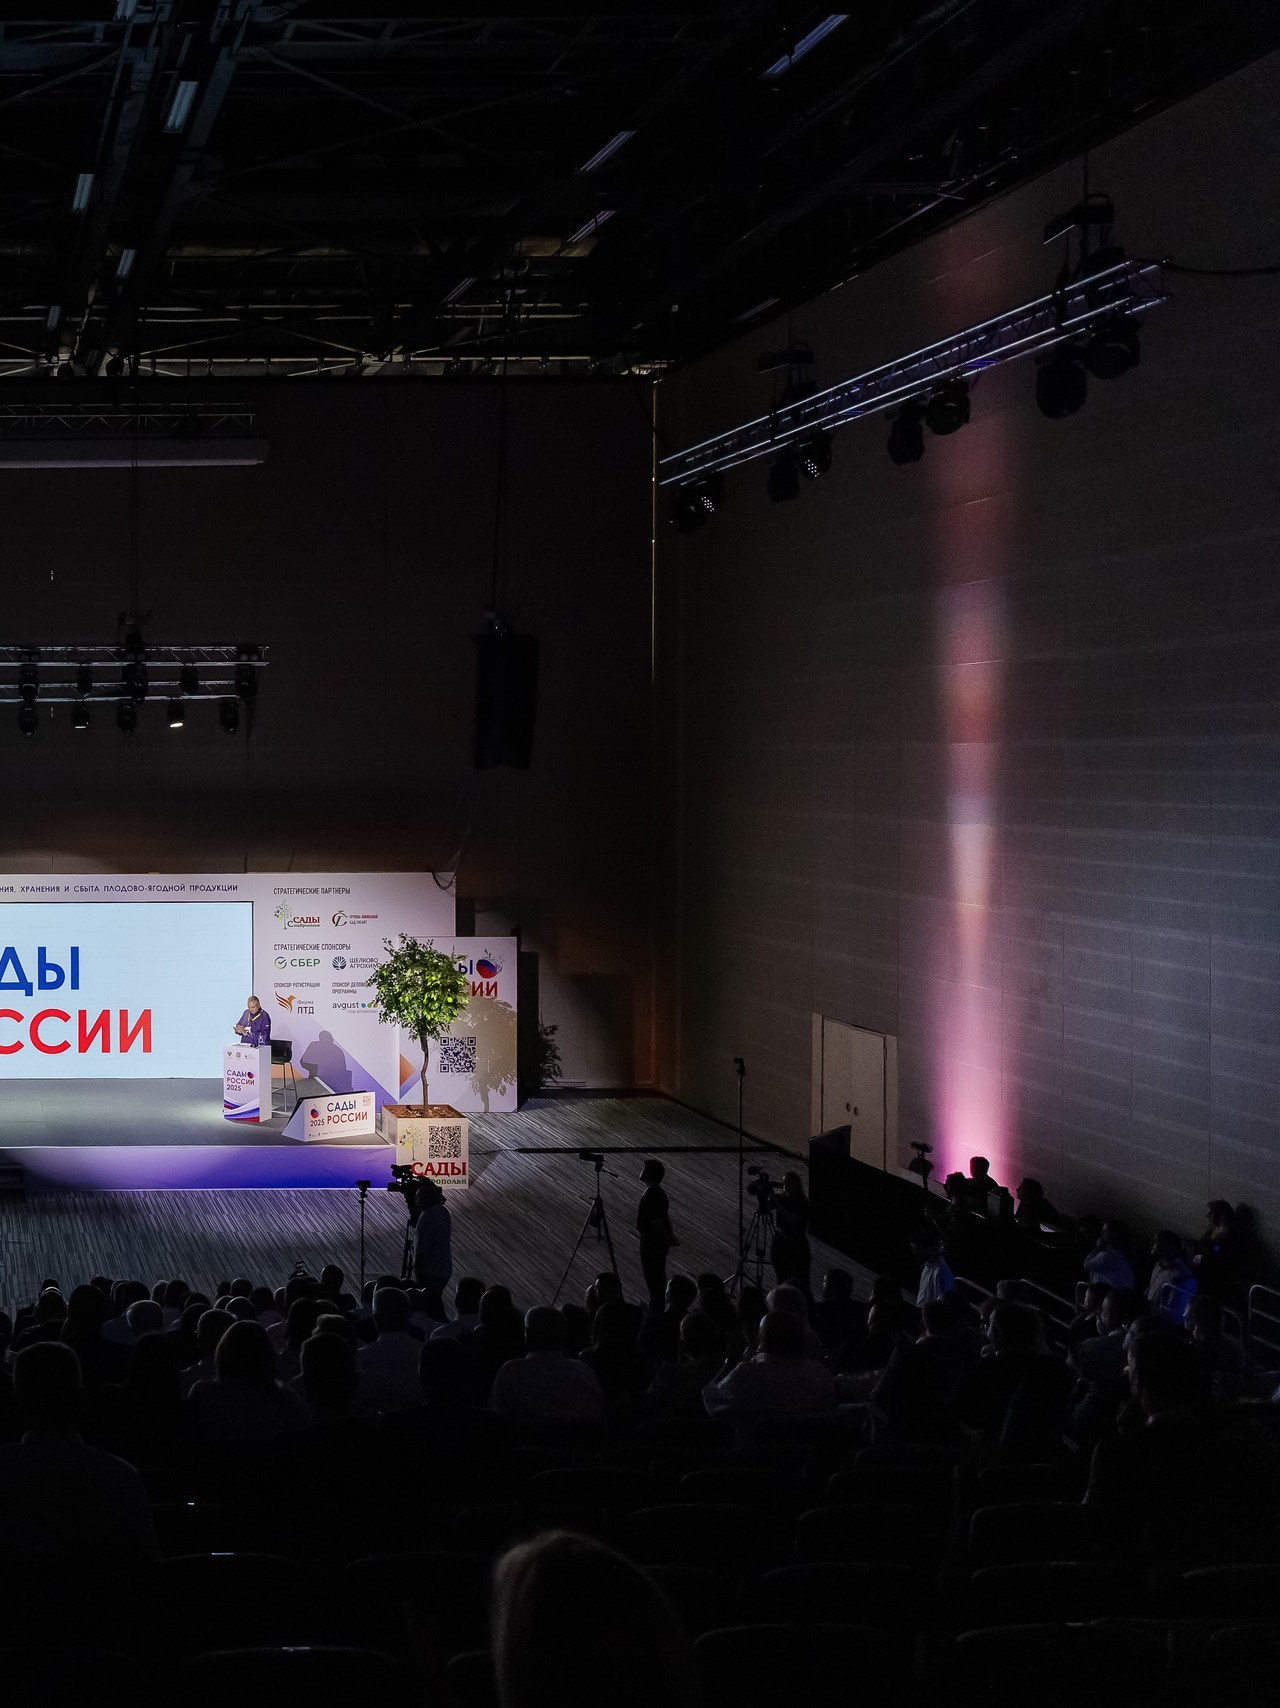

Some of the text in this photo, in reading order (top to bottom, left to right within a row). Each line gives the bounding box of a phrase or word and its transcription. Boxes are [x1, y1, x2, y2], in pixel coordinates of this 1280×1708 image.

[20, 885, 60, 893] ХРАНЕНИЯ
[64, 885, 70, 893] И
[73, 885, 100, 893] СБЫТА
[103, 884, 186, 892] ПЛОДОВО-ЯГОДНОЙ
[189, 884, 238, 892] ПРОДУКЦИИ
[273, 887, 351, 895] СТРАТЕГИЧЕСКИЕ ПАРТНЕРЫ
[293, 916, 320, 924] САДЫ
[273, 943, 351, 951] СТРАТЕГИЧЕСКИЕ СПОНСОРЫ
[290, 958, 320, 967] СБЕР
[332, 1001, 360, 1010] avgust
[297, 1006, 315, 1015] ЛТД
[226, 1069, 247, 1077] САДЫ
[226, 1076, 255, 1085] РОССИИ
[326, 1100, 357, 1112] САДЫ
[309, 1111, 368, 1127] 2025 РОССИИ
[411, 1161, 467, 1177] САДЫ
